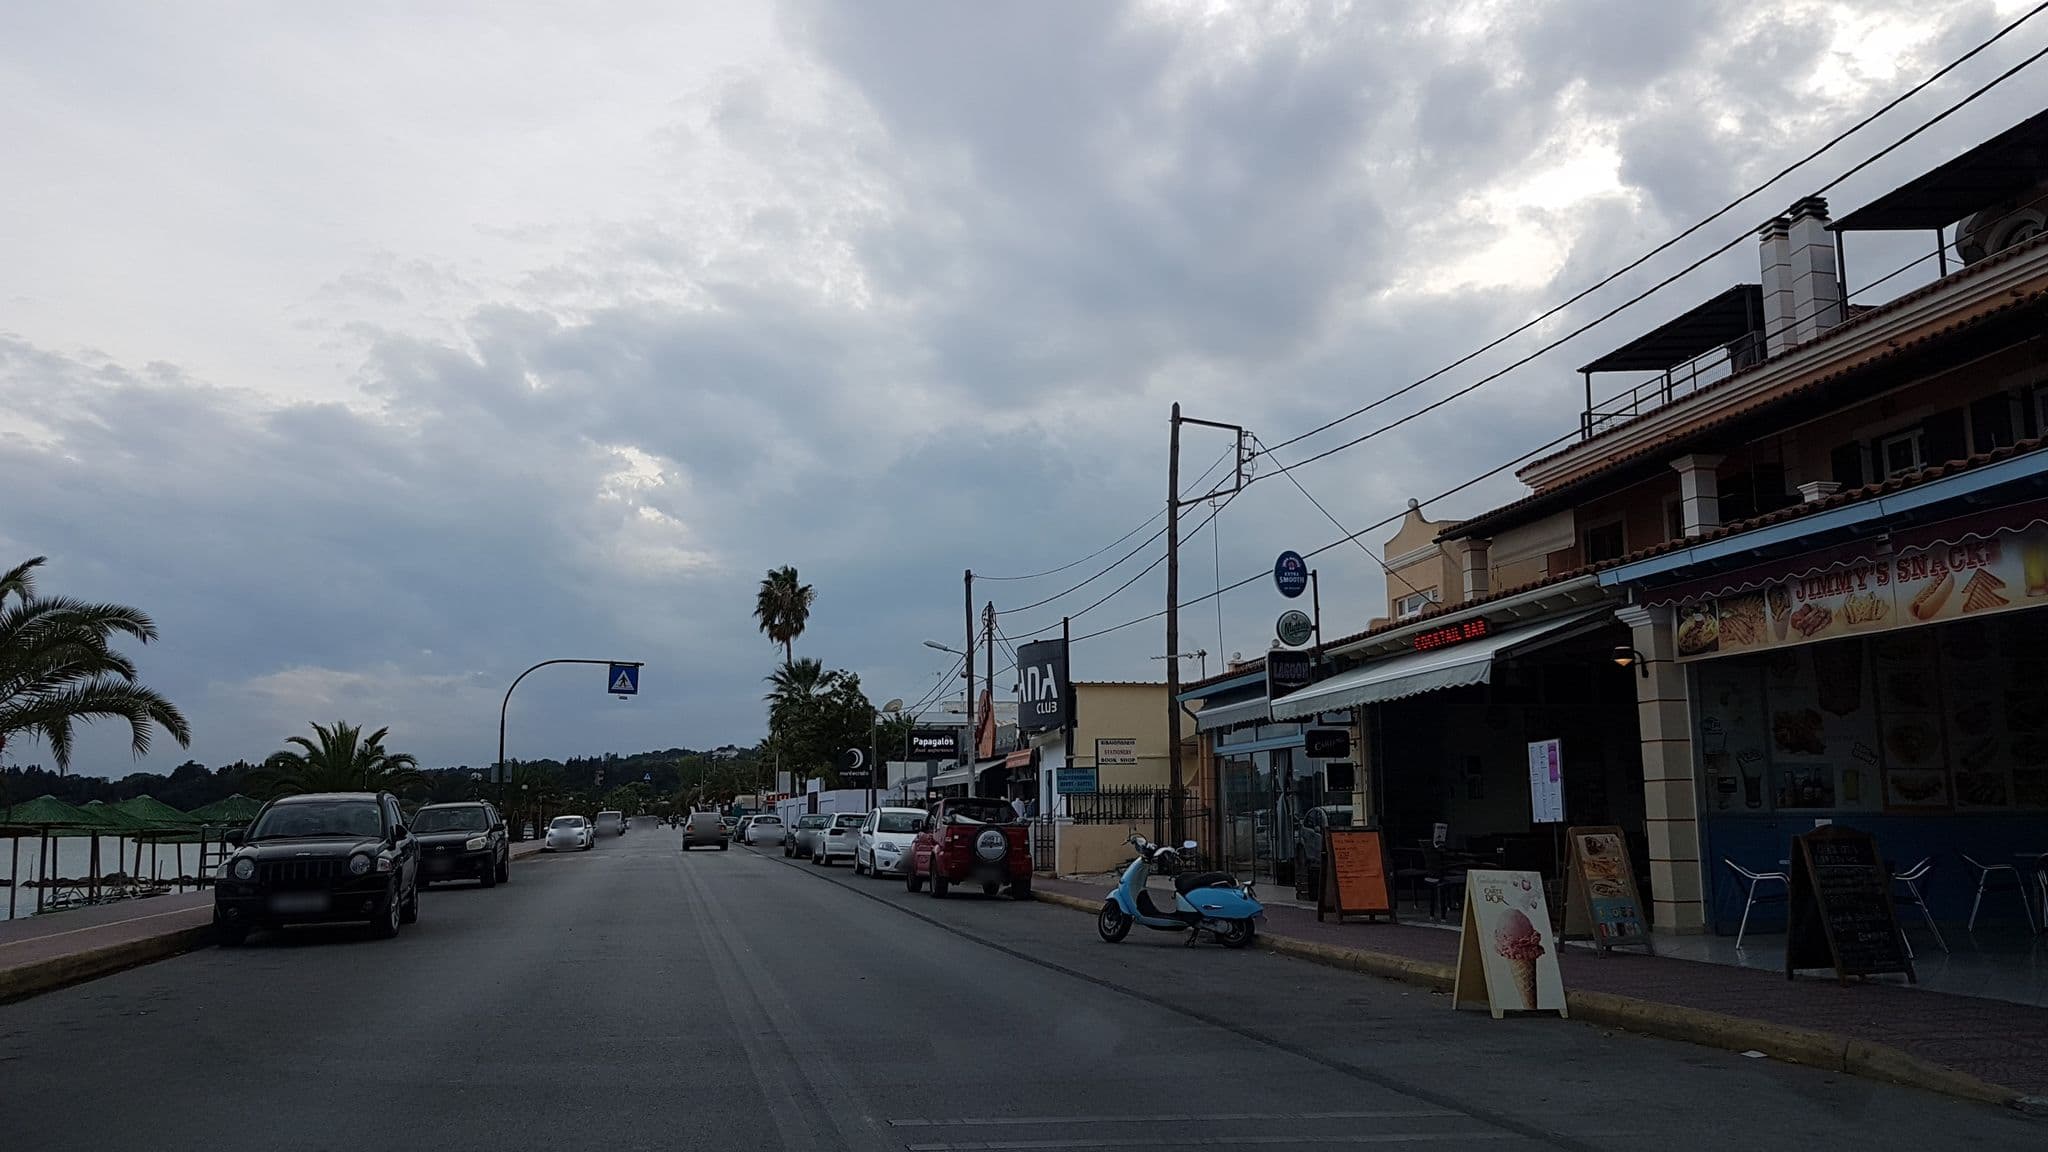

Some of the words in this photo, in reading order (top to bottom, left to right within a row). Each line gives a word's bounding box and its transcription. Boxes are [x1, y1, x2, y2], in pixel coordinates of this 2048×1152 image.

[1795, 562, 1889, 602] JIMMY'S
[1413, 627, 1462, 650] COCKTAIL
[1463, 619, 1486, 639] BAR
[1036, 701, 1058, 715] CLUB
[913, 736, 954, 748] Papagalos
